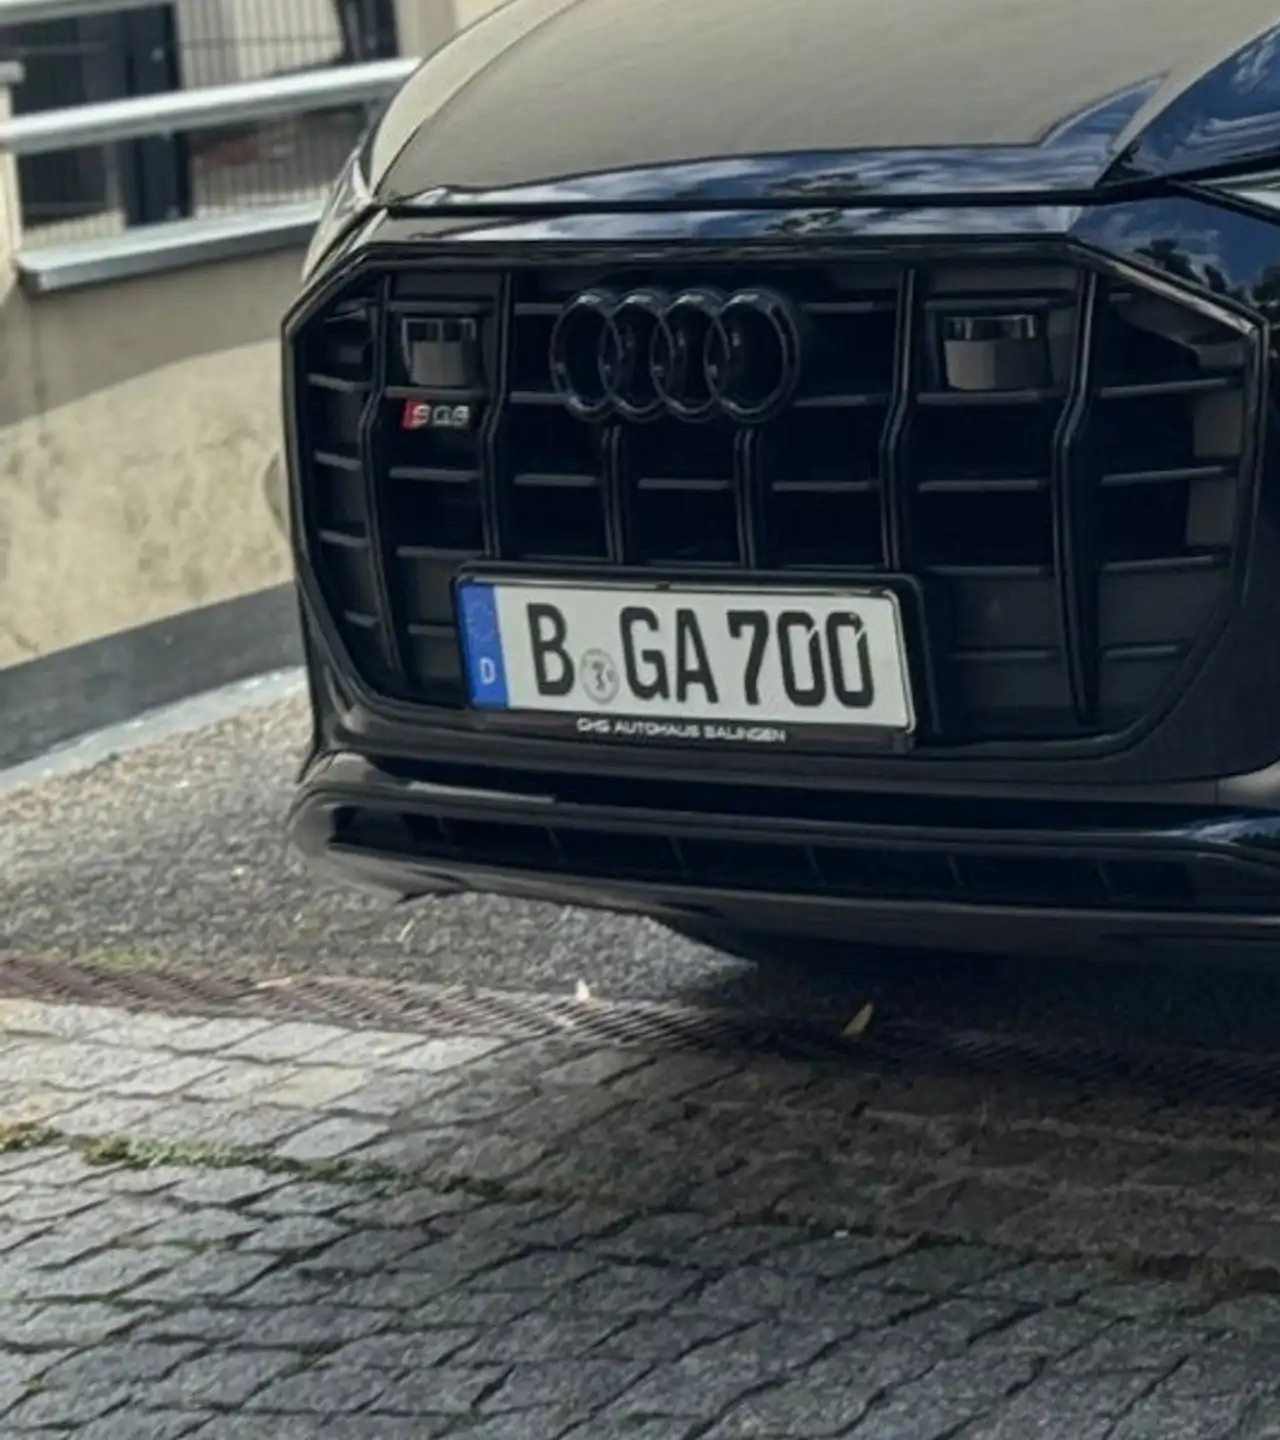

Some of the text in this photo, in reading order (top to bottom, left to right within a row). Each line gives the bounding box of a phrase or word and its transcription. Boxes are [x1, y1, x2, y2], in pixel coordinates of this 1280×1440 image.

[411, 404, 470, 428] SQ8
[527, 602, 875, 708] B GA 700
[480, 657, 496, 685] D
[614, 719, 700, 738] AUTOHAUS
